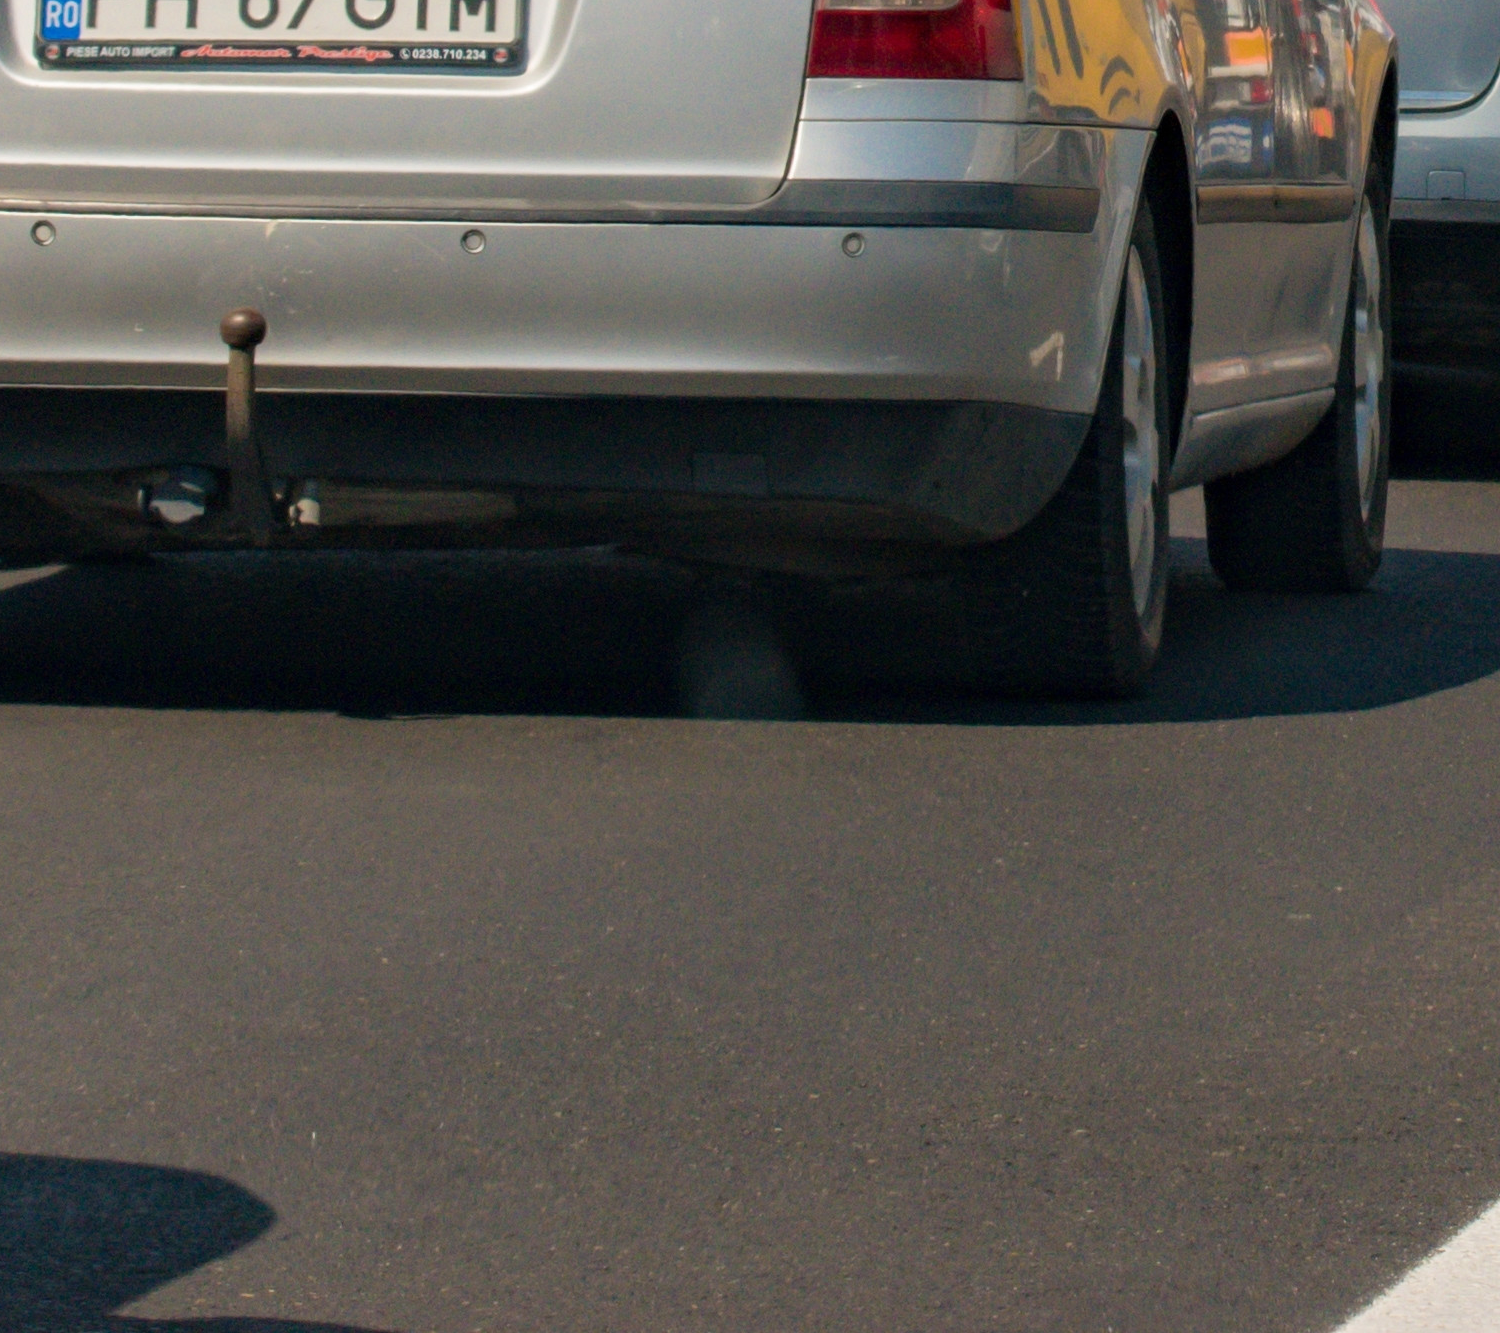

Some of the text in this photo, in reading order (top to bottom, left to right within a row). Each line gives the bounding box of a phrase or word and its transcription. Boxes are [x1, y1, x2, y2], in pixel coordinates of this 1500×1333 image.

[45, 0, 79, 29] RO
[66, 46, 99, 58] PIESE
[99, 46, 131, 58] AUTO
[131, 46, 176, 58] IMPORT
[411, 47, 487, 60] 0238.710.234
